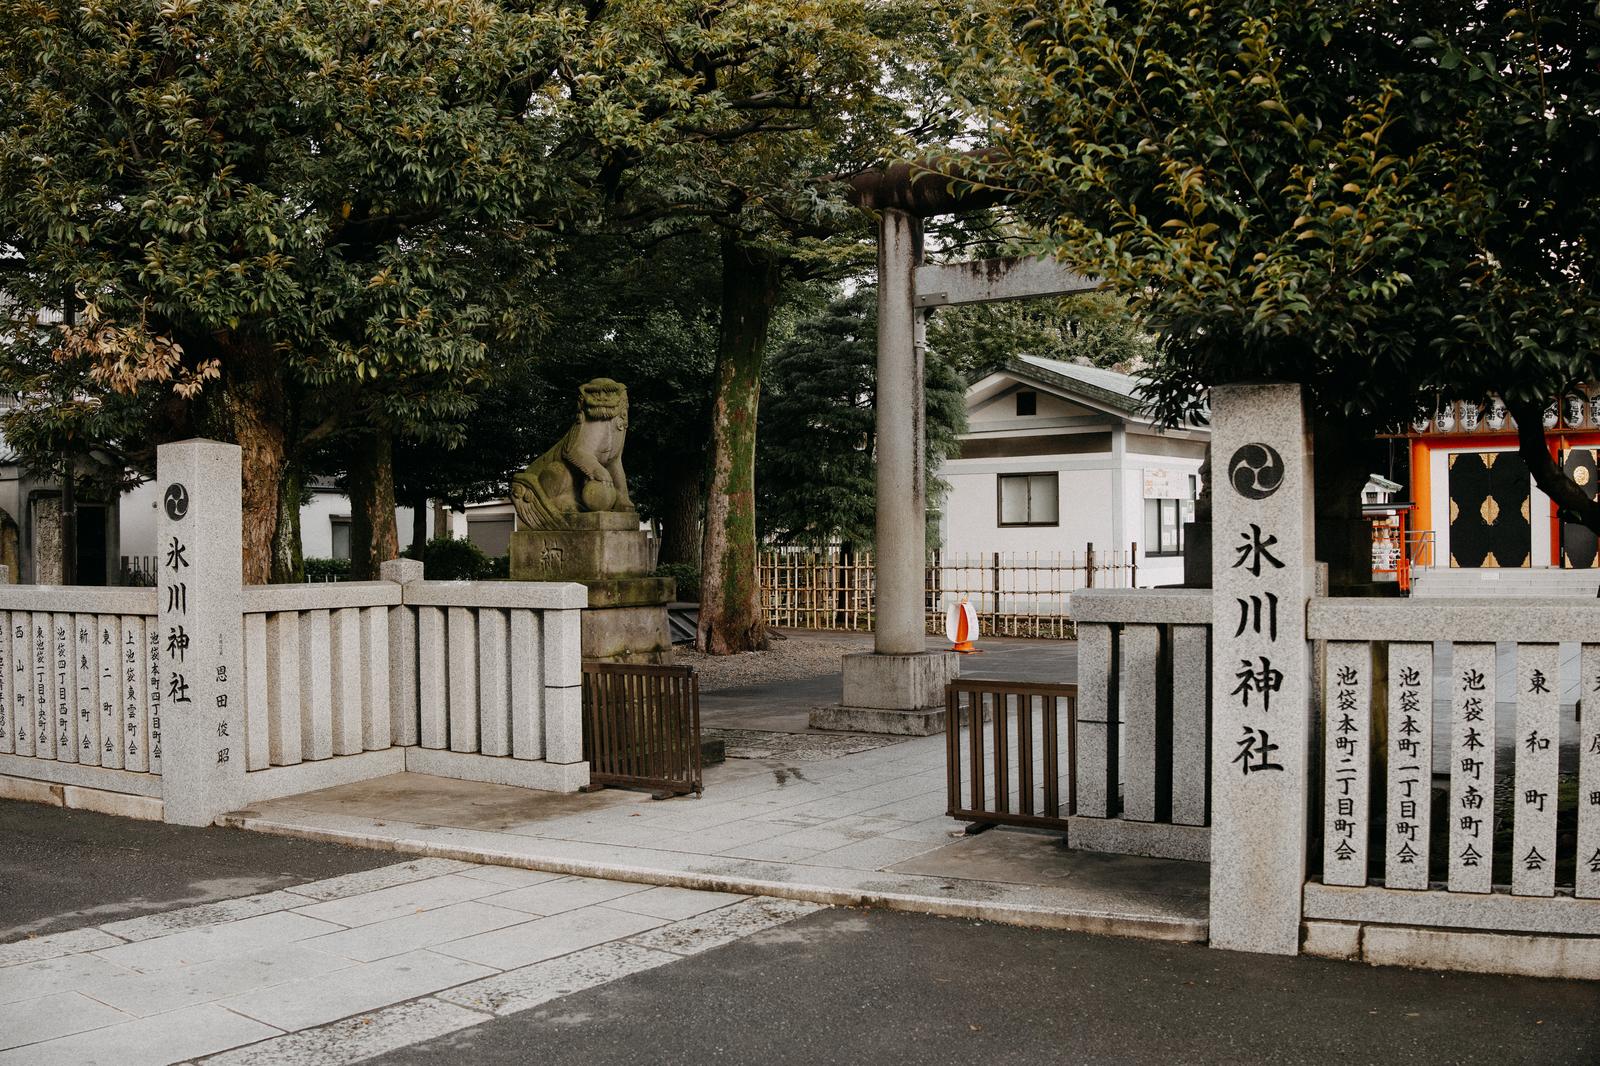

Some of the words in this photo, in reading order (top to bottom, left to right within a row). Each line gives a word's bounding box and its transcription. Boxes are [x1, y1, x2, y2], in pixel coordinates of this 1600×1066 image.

[15, 625, 26, 741] 西山町会
[165, 536, 192, 704] 氷川神社
[1231, 523, 1286, 776] 氷川神社
[36, 625, 48, 744] 東池袋一丁目中央町会
[56, 626, 69, 746] 池袋四丁目西町会
[79, 627, 92, 750] 新東一町会
[102, 628, 115, 752] 東二町会
[125, 630, 138, 755] 上池袋東雲町会
[150, 631, 162, 759] 池袋本町四丁目町会
[216, 665, 230, 764] 恩田俊昭
[1334, 665, 1359, 861] 池袋本町二丁目町会
[1395, 666, 1422, 865] 池袋本町一丁目町会
[1459, 668, 1487, 868] 池袋本町南町会
[1523, 669, 1551, 872] 東和町会
